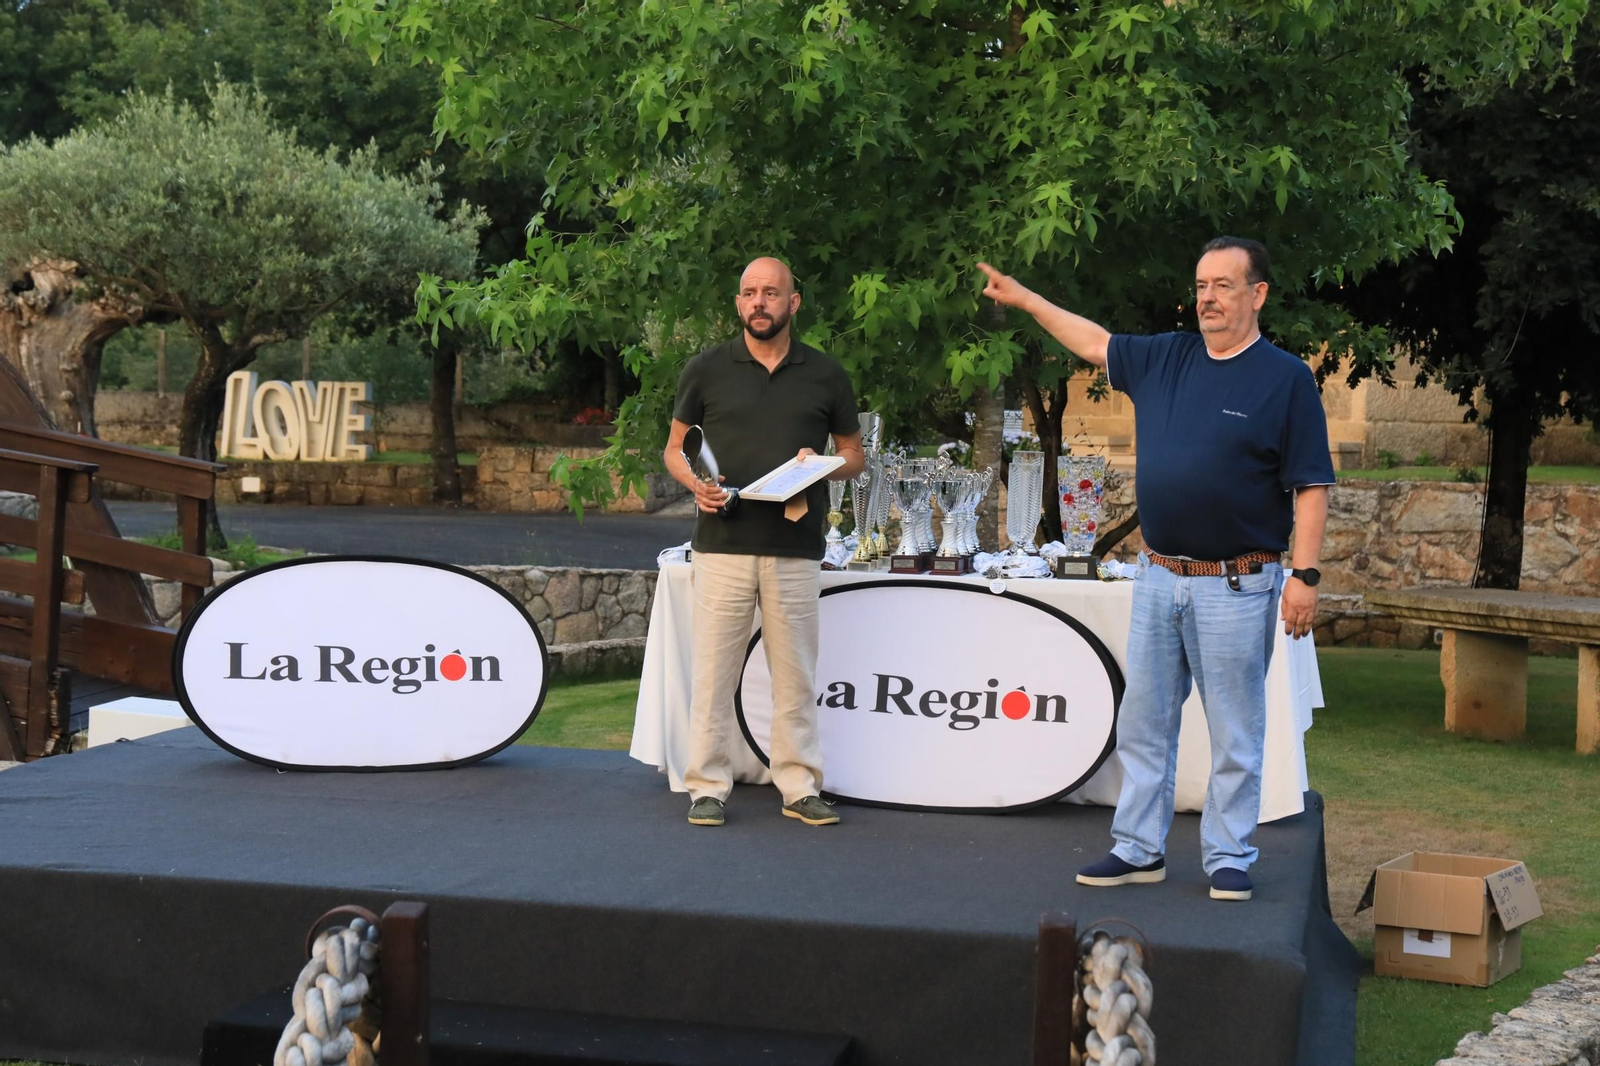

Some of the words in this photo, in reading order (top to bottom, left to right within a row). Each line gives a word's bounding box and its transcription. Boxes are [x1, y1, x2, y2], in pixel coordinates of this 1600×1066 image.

[220, 370, 372, 461] LOVE
[223, 642, 303, 682] La
[314, 643, 503, 695] Región
[816, 680, 859, 710] a
[869, 673, 1069, 731] Región
